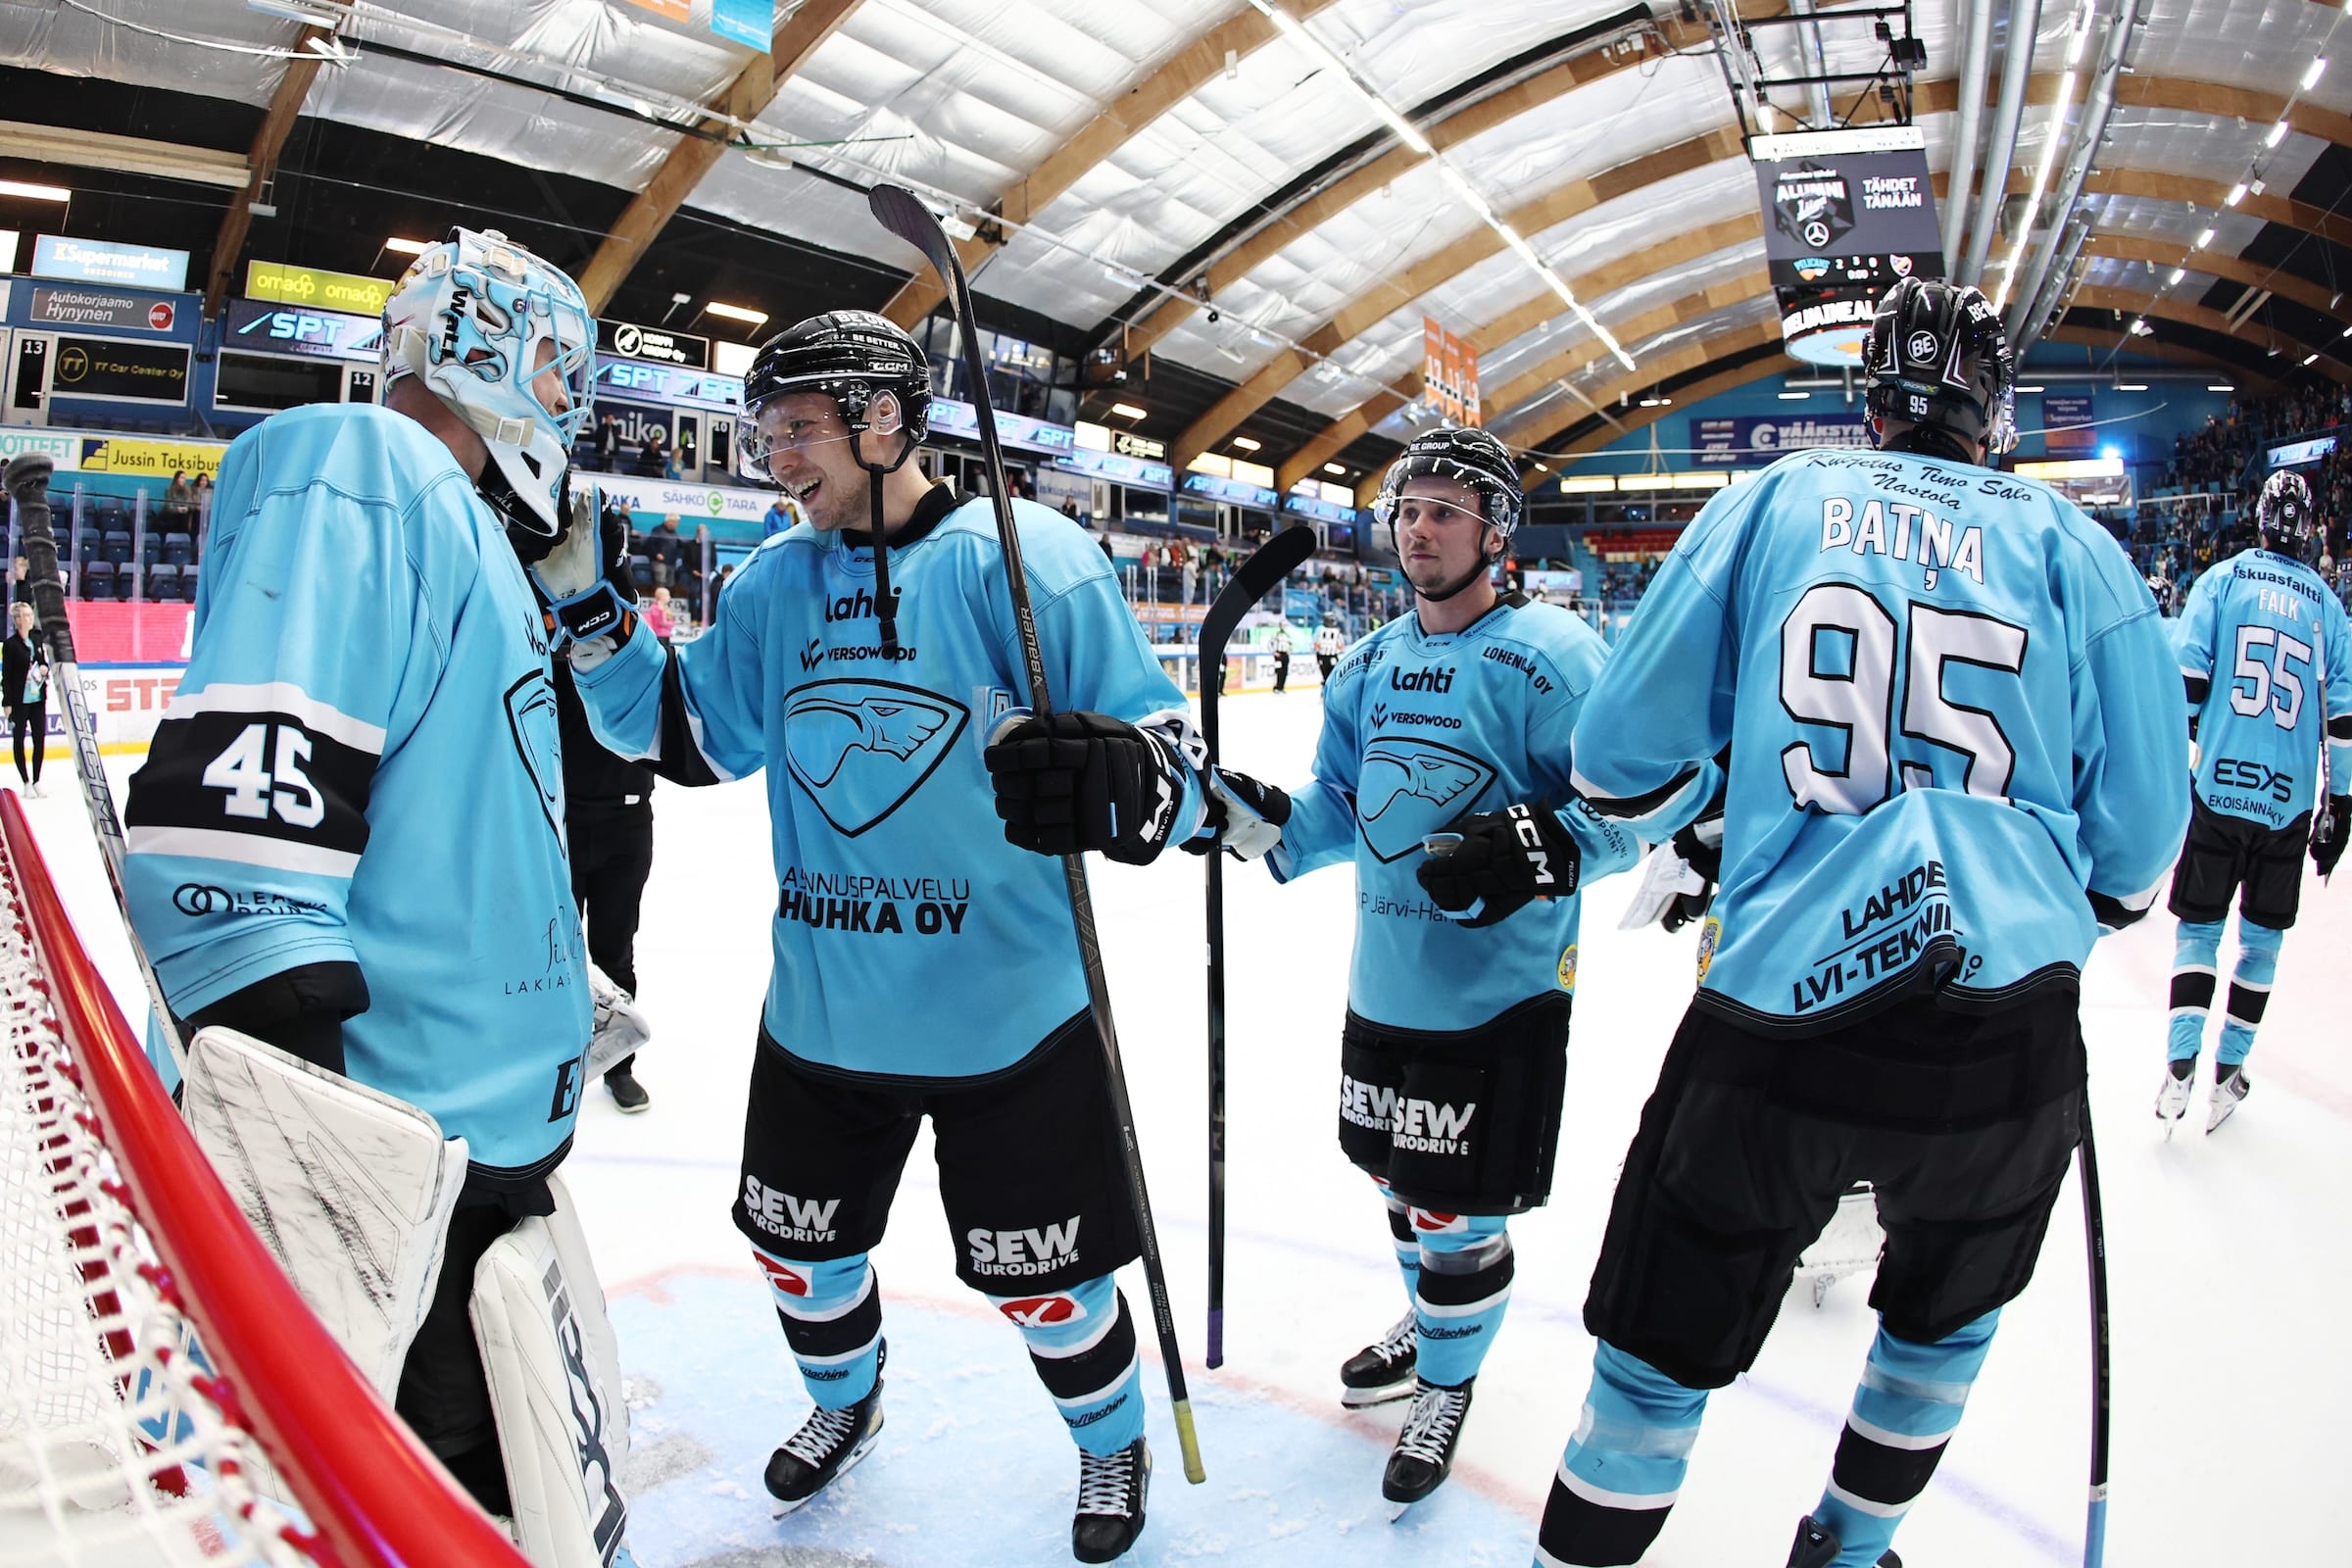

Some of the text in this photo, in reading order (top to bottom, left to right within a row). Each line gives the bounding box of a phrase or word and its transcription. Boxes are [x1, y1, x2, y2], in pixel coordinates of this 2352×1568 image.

[1777, 180, 1845, 202] ALUMNI
[1863, 176, 1917, 193] TÄHDET
[1863, 192, 1922, 209] TÄNÄÄN
[48, 291, 133, 310] Autokorjaamo
[46, 303, 114, 322] Hynynen
[270, 312, 345, 344] SPT
[24, 341, 43, 355] 13
[1911, 336, 1935, 358] BE
[110, 363, 128, 374] Car
[169, 367, 184, 380] Oy
[353, 373, 371, 386] 12
[611, 363, 670, 393] SPT
[928, 402, 960, 425] PT
[1909, 395, 1928, 416] 95
[1038, 426, 1074, 450] SPT
[1421, 442, 1450, 451] GROUP
[113, 450, 155, 467] Jussin
[1873, 473, 1962, 510] Nastola
[1920, 466, 1969, 487] Timo
[1978, 480, 2034, 503] Salo
[725, 498, 758, 512] TARA
[2266, 554, 2312, 574] GATORADE
[2258, 588, 2300, 622] FALK
[1392, 665, 1456, 694] Lahti
[1533, 674, 1554, 696] OY
[2230, 624, 2313, 732] 55
[1780, 582, 2026, 815] 95
[1391, 711, 1462, 729] VERSOWOOD
[202, 723, 325, 829] 45
[1506, 803, 1555, 885] CCM
[1598, 821, 1620, 855] POINT
[779, 888, 969, 935] HUHKA OY
[1342, 1074, 1399, 1118] SEW
[1393, 1096, 1476, 1140] SEW
[1392, 1132, 1470, 1155] URODRIVE
[743, 1174, 841, 1232] SEW
[967, 1215, 1081, 1264] SEW
[972, 1250, 1080, 1276] EURODRIVE
